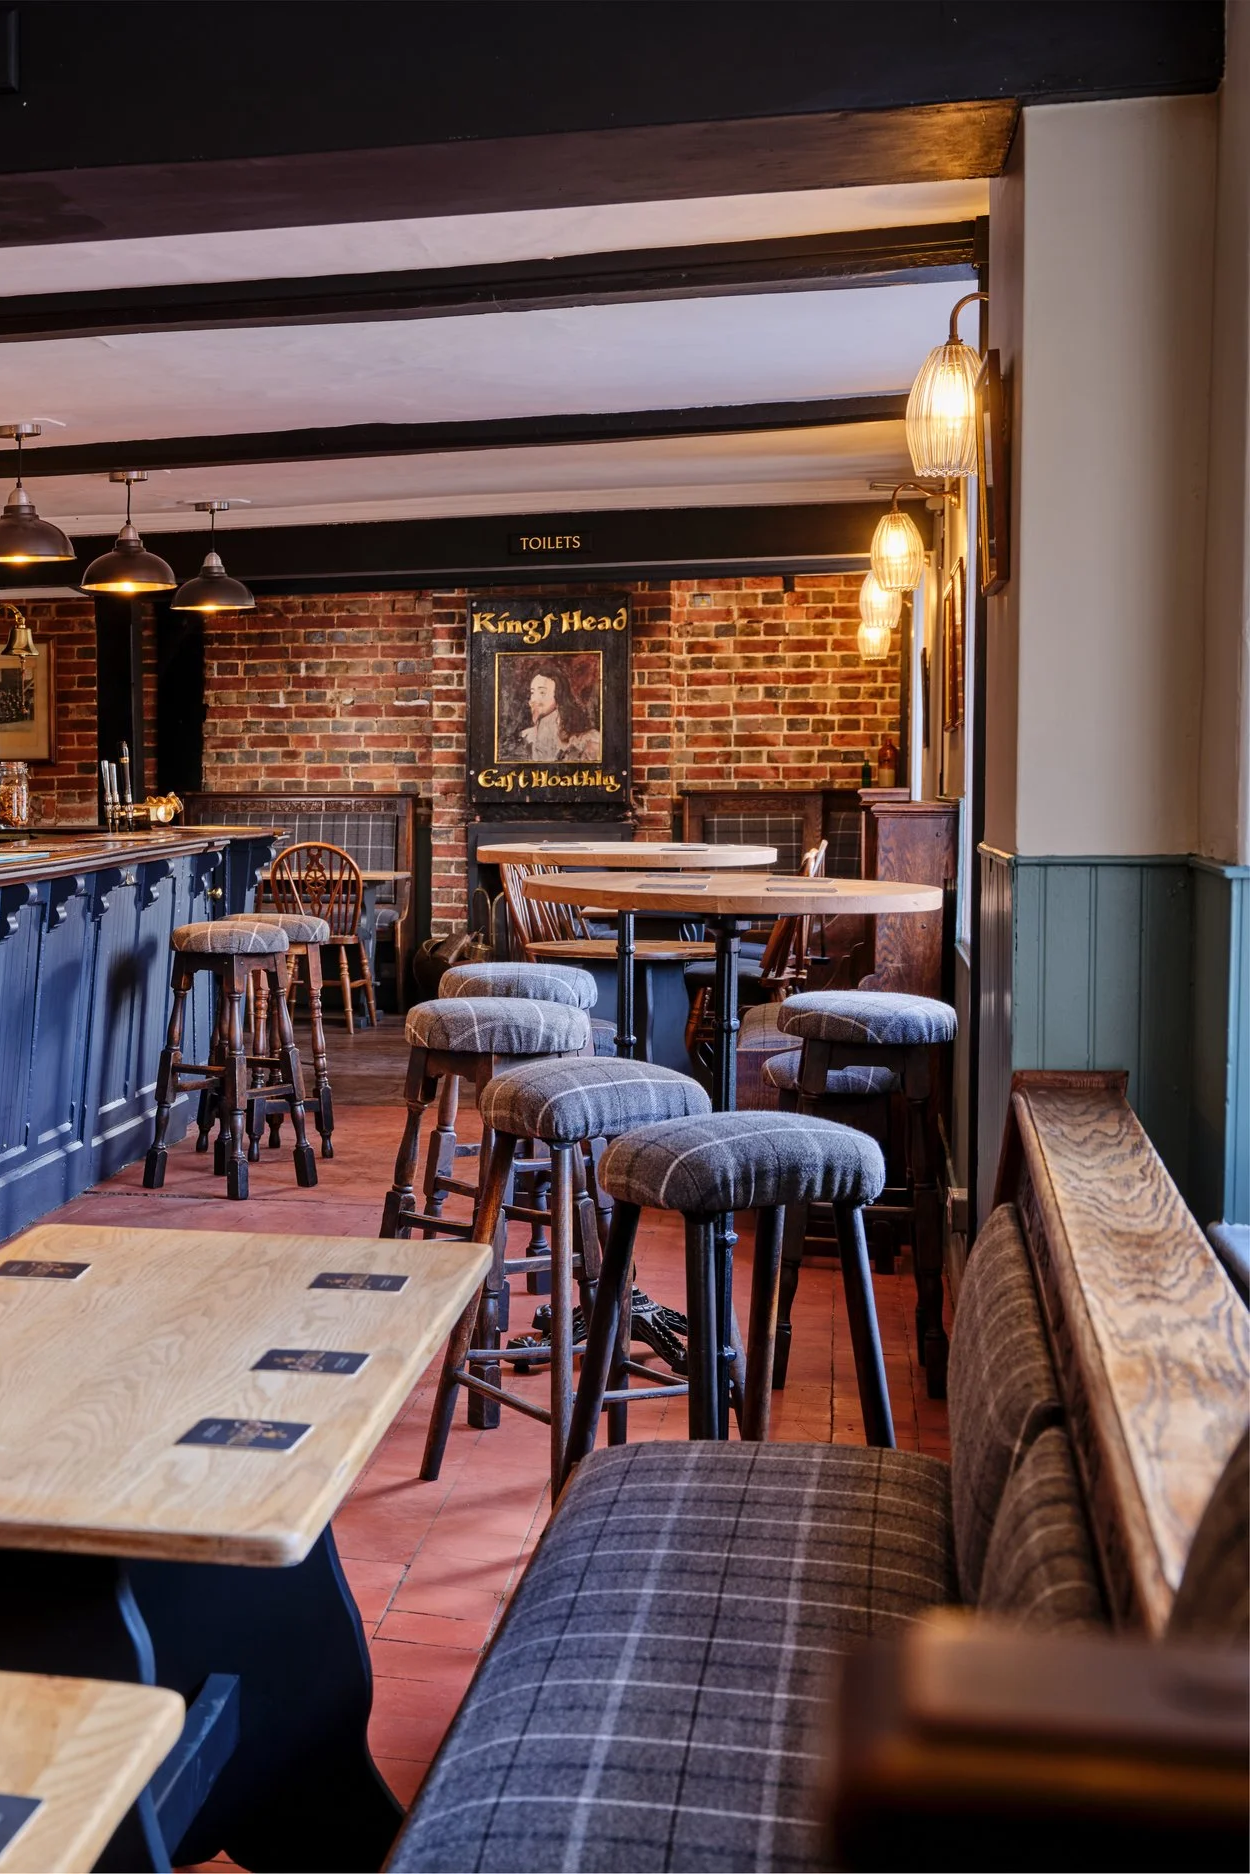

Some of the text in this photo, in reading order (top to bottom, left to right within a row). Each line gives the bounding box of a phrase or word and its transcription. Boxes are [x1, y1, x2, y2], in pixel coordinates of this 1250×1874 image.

[519, 535, 581, 550] TOILETS
[560, 608, 628, 634] Head
[530, 769, 621, 793] Hoathly
